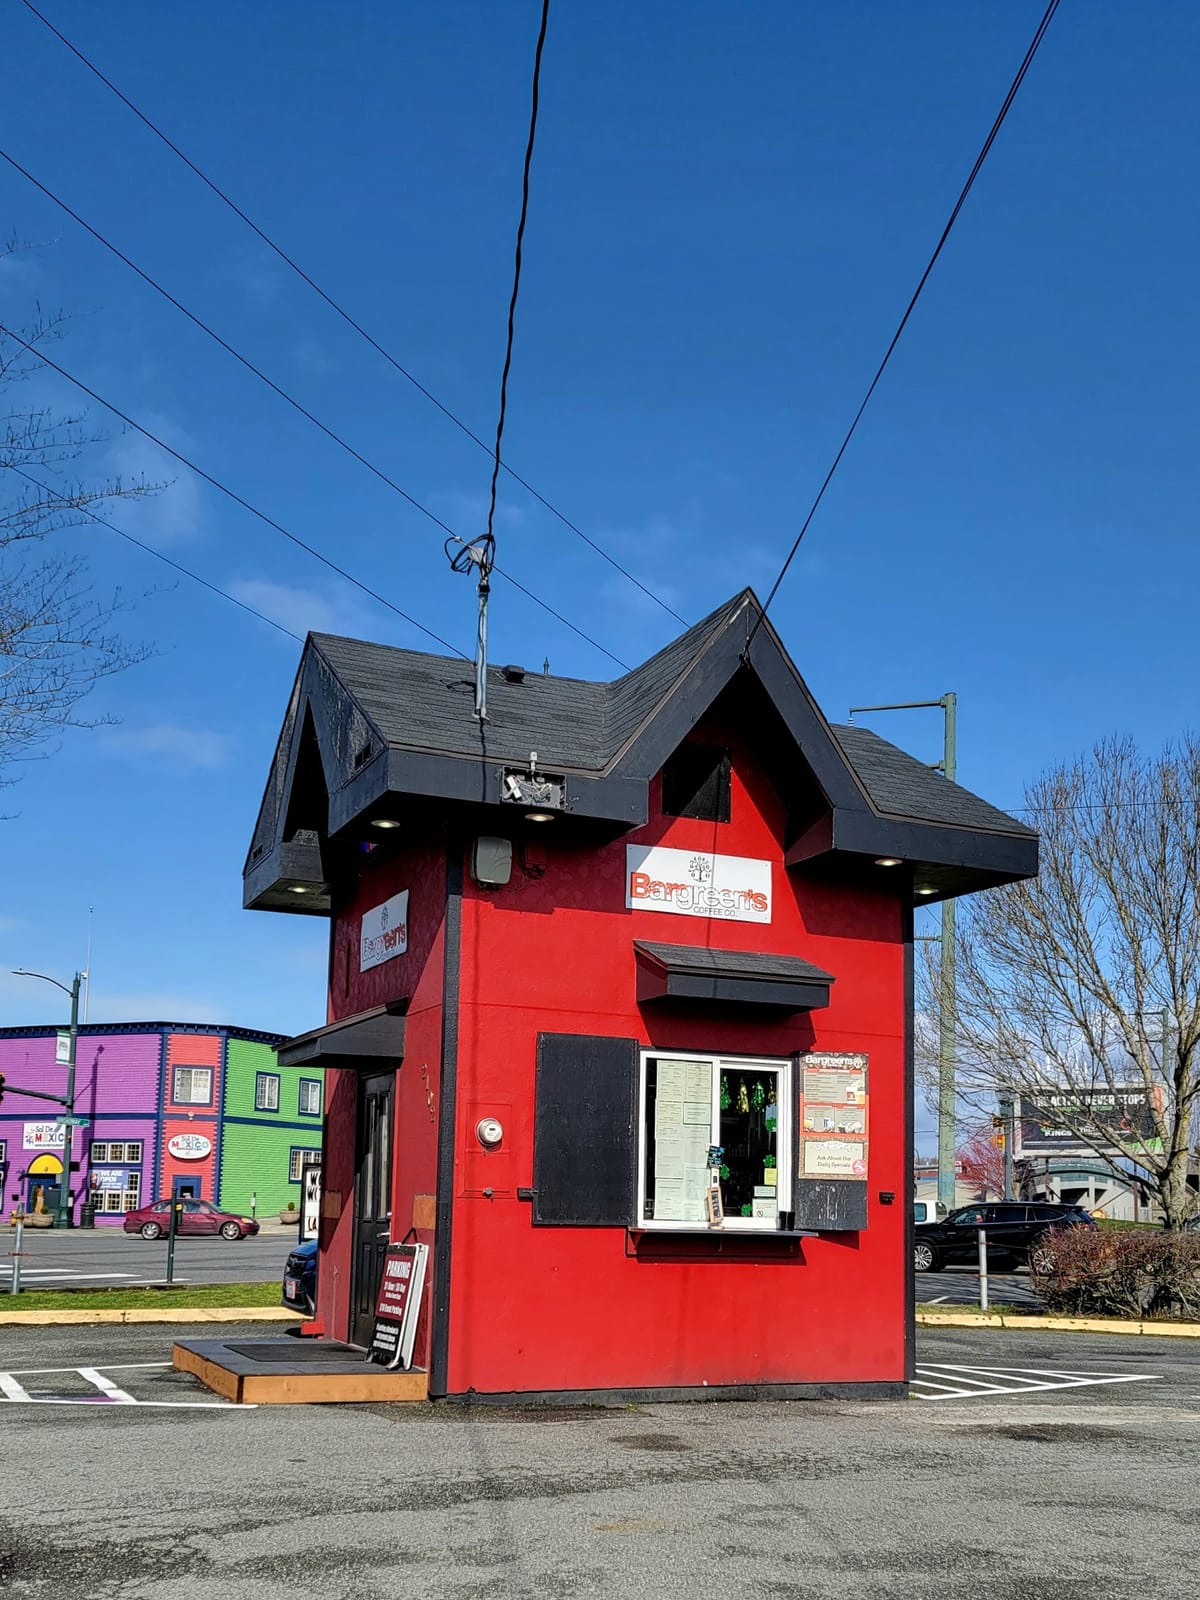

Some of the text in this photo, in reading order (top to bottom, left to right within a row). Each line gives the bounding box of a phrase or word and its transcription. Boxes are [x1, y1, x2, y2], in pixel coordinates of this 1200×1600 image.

[631, 872, 768, 912] Bargreen's
[693, 906, 738, 917] COFFEE CO.
[1085, 1094, 1115, 1106] NEVER
[35, 1125, 44, 1133] Sol
[35, 1133, 64, 1143] MEXIC
[386, 1260, 411, 1279] PARKING
